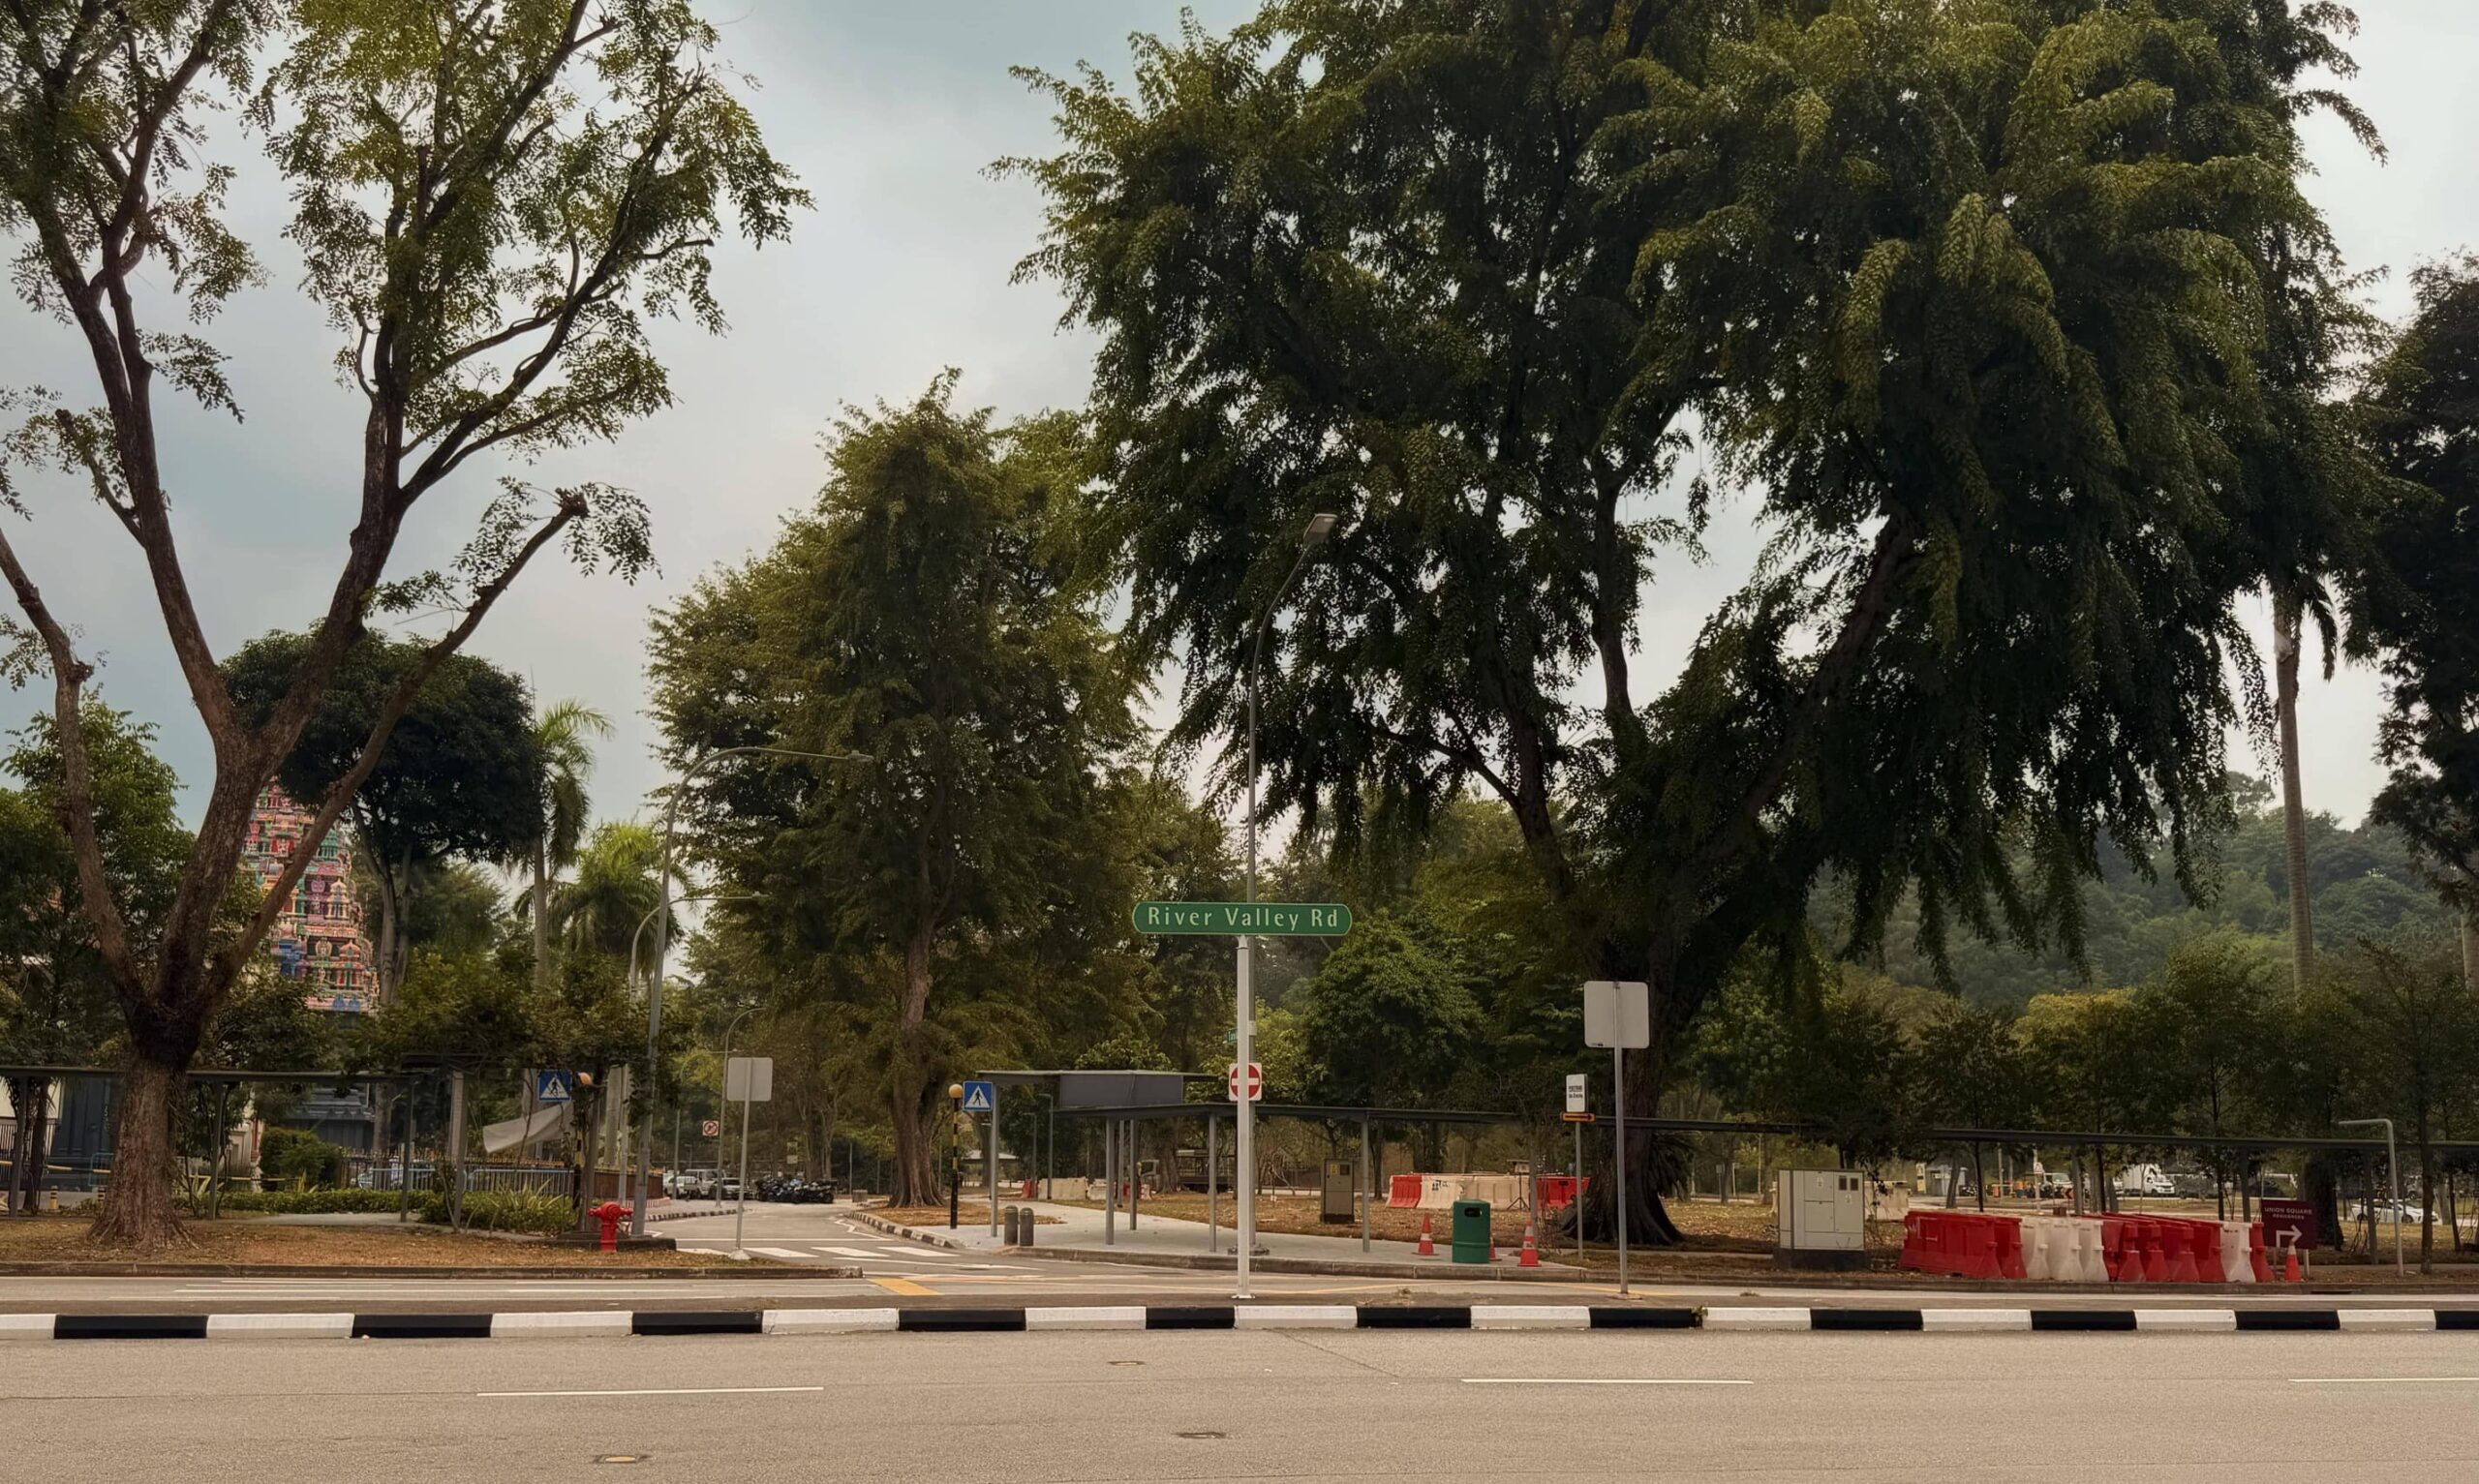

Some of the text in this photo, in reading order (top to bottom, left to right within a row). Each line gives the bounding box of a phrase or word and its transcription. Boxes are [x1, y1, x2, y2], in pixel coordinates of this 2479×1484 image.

[1148, 906, 1338, 931] River Valley Rd
